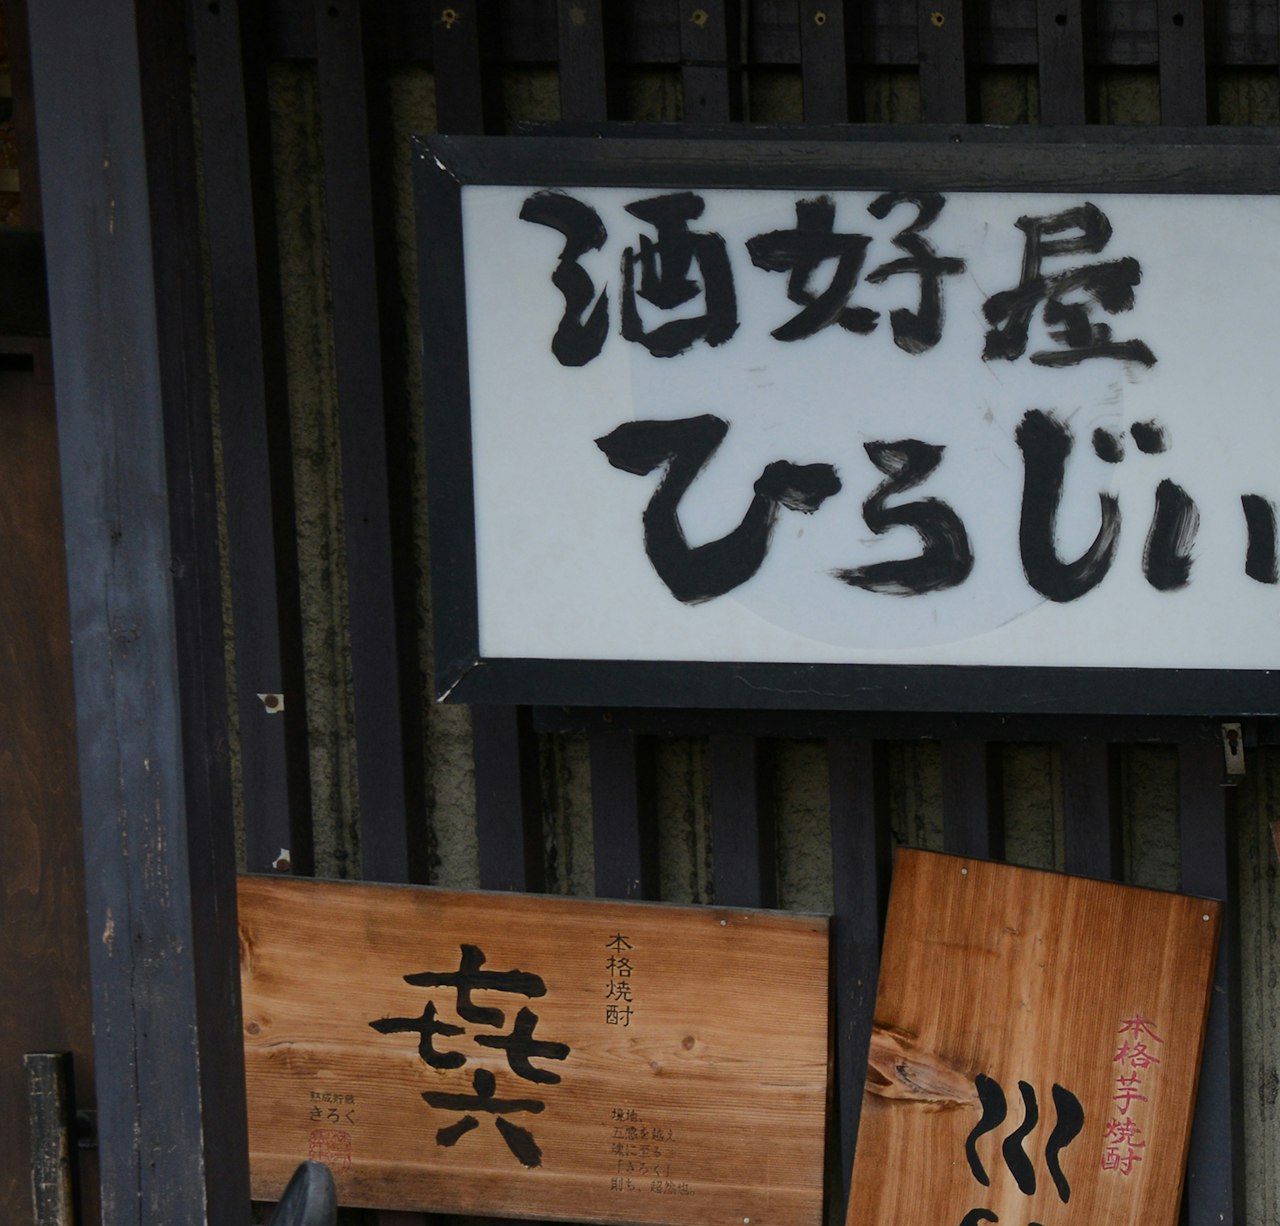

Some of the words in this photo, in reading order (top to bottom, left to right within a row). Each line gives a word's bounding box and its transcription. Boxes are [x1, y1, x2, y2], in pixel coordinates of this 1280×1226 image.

[519, 188, 1158, 368] 酒好屋
[594, 409, 1279, 605] ひろじい
[605, 932, 634, 1027] 本格焼酎
[310, 1105, 356, 1125] きろく
[1101, 1013, 1165, 1176] 本格芋焼酎
